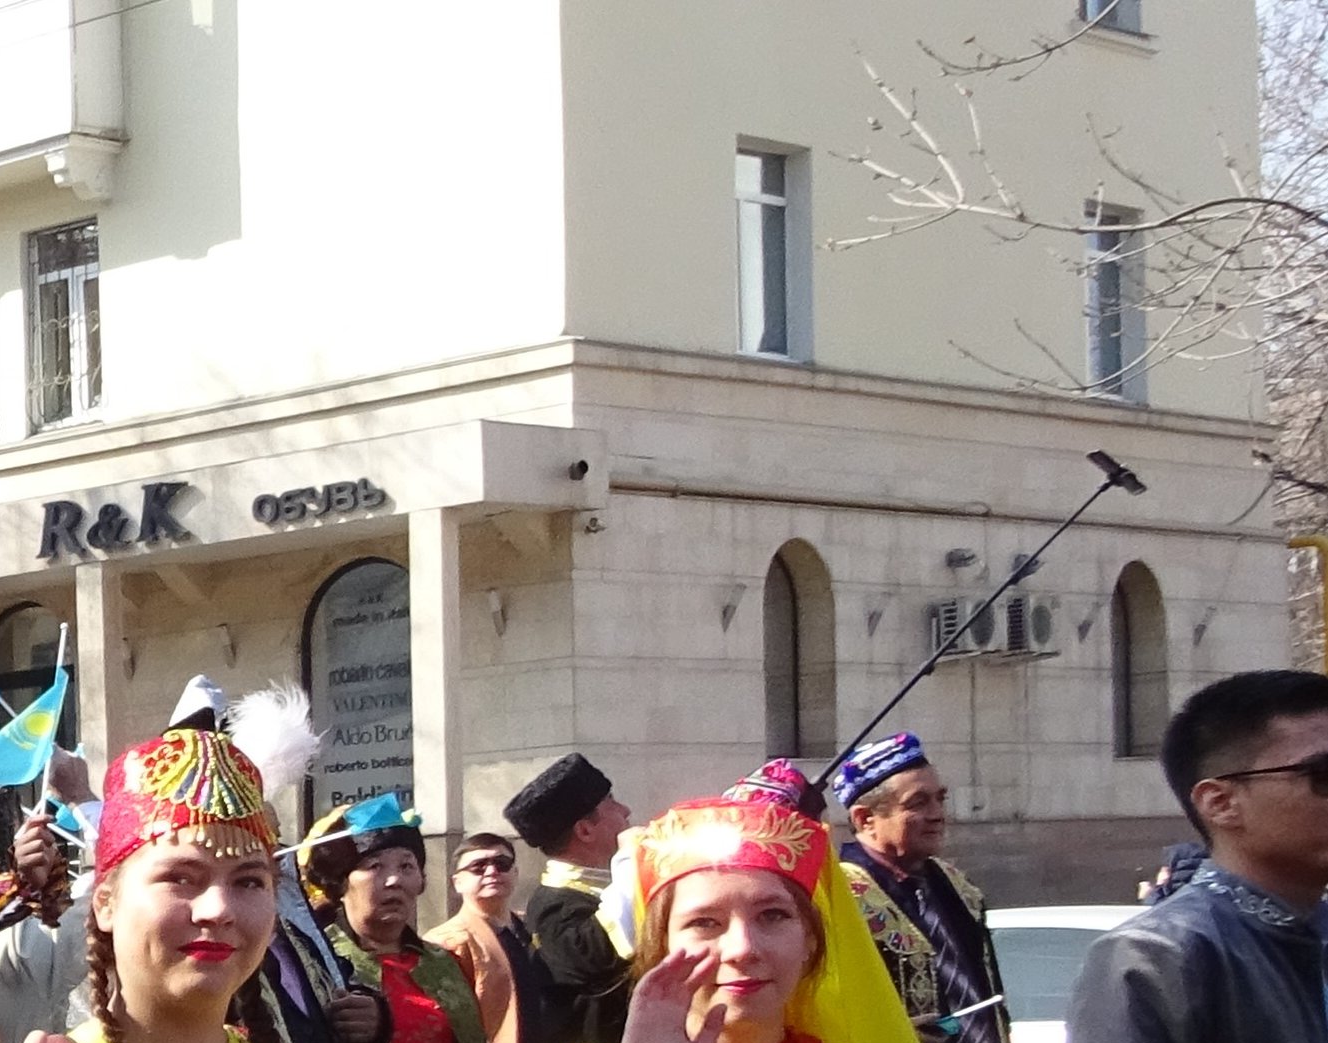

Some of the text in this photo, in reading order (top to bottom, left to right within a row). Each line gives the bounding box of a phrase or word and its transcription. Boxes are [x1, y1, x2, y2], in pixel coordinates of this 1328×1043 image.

[253, 477, 387, 524] ОБУВЬ
[37, 482, 193, 559] R&K
[332, 692, 411, 712] VALENTIN
[333, 724, 372, 746] Aldo
[324, 759, 368, 774] roberto
